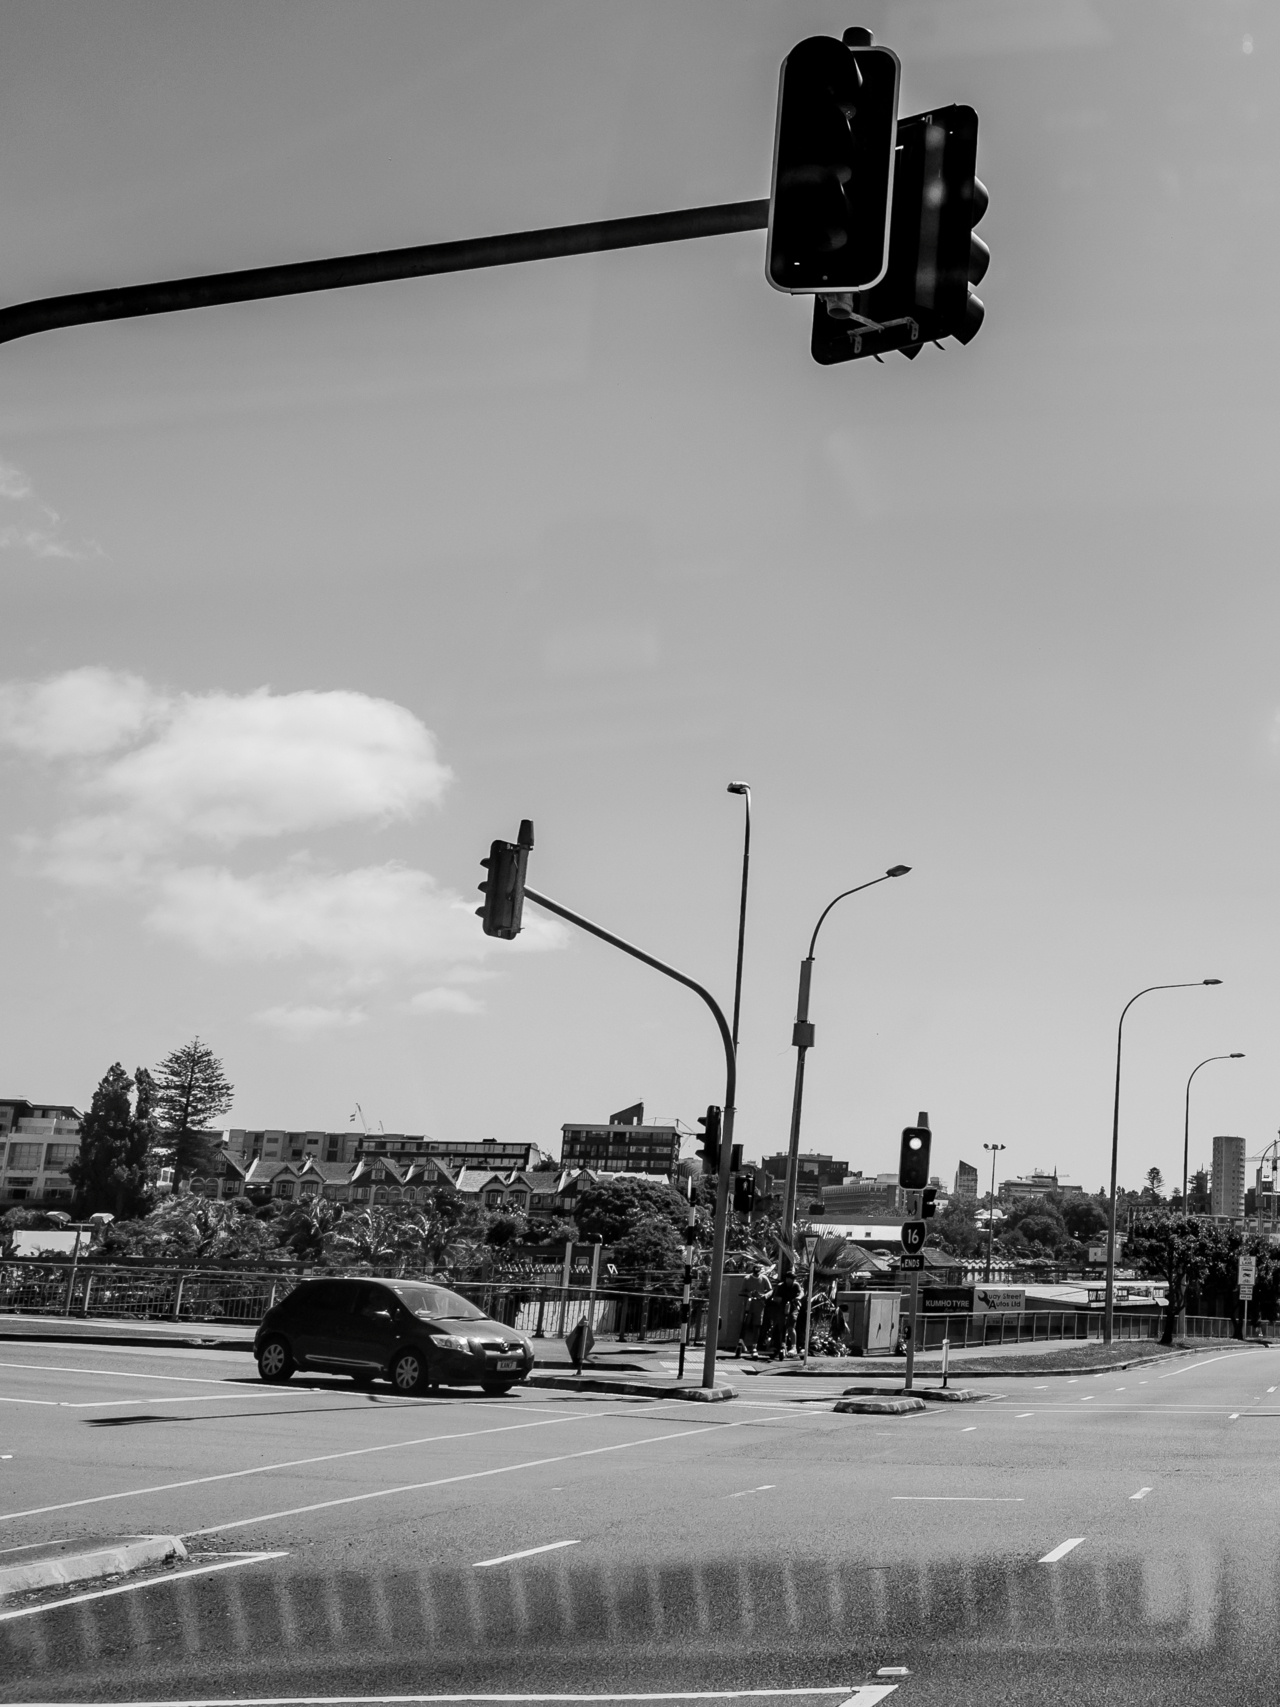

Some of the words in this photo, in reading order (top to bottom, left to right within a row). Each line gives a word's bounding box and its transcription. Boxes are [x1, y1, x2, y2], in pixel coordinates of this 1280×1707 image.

[907, 1229, 919, 1244] 16
[905, 1259, 920, 1268] ENDS
[925, 1299, 952, 1307] KUMHO
[952, 1299, 970, 1308] TYRE
[988, 1300, 1010, 1310] Autos
[1011, 1299, 1021, 1307] Ltd
